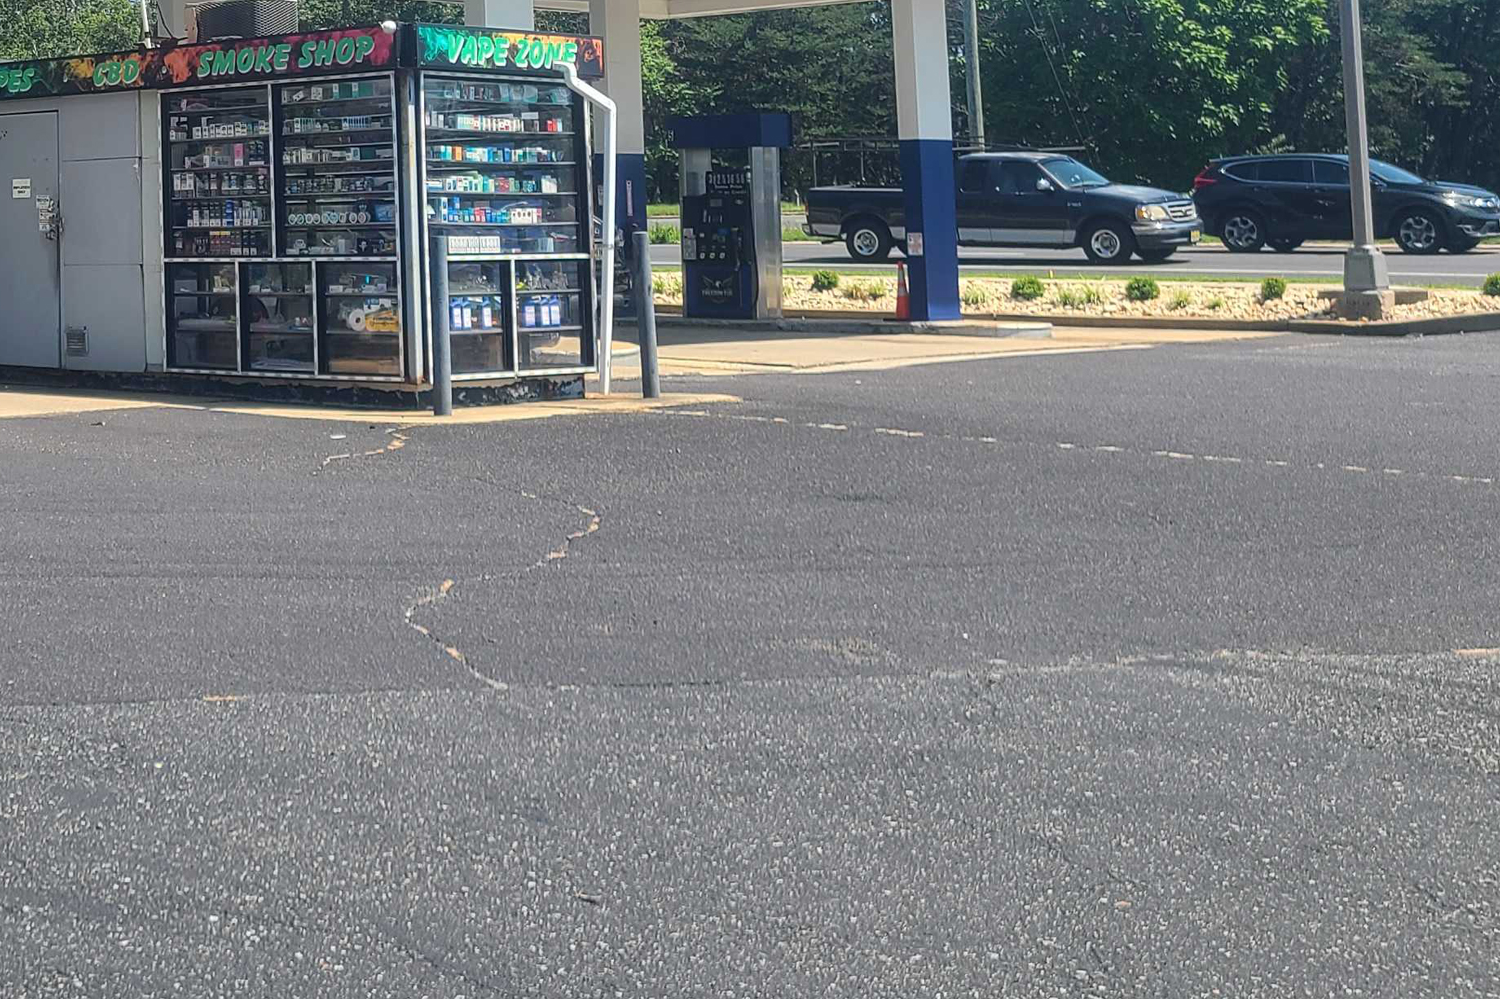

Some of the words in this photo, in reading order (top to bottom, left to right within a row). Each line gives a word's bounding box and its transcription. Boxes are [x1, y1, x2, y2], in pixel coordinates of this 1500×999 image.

[92, 59, 140, 87] CBD
[197, 43, 292, 78] SMOKE
[298, 35, 376, 69] SHOP
[447, 34, 510, 67] VAPE
[514, 38, 578, 70] ZONE
